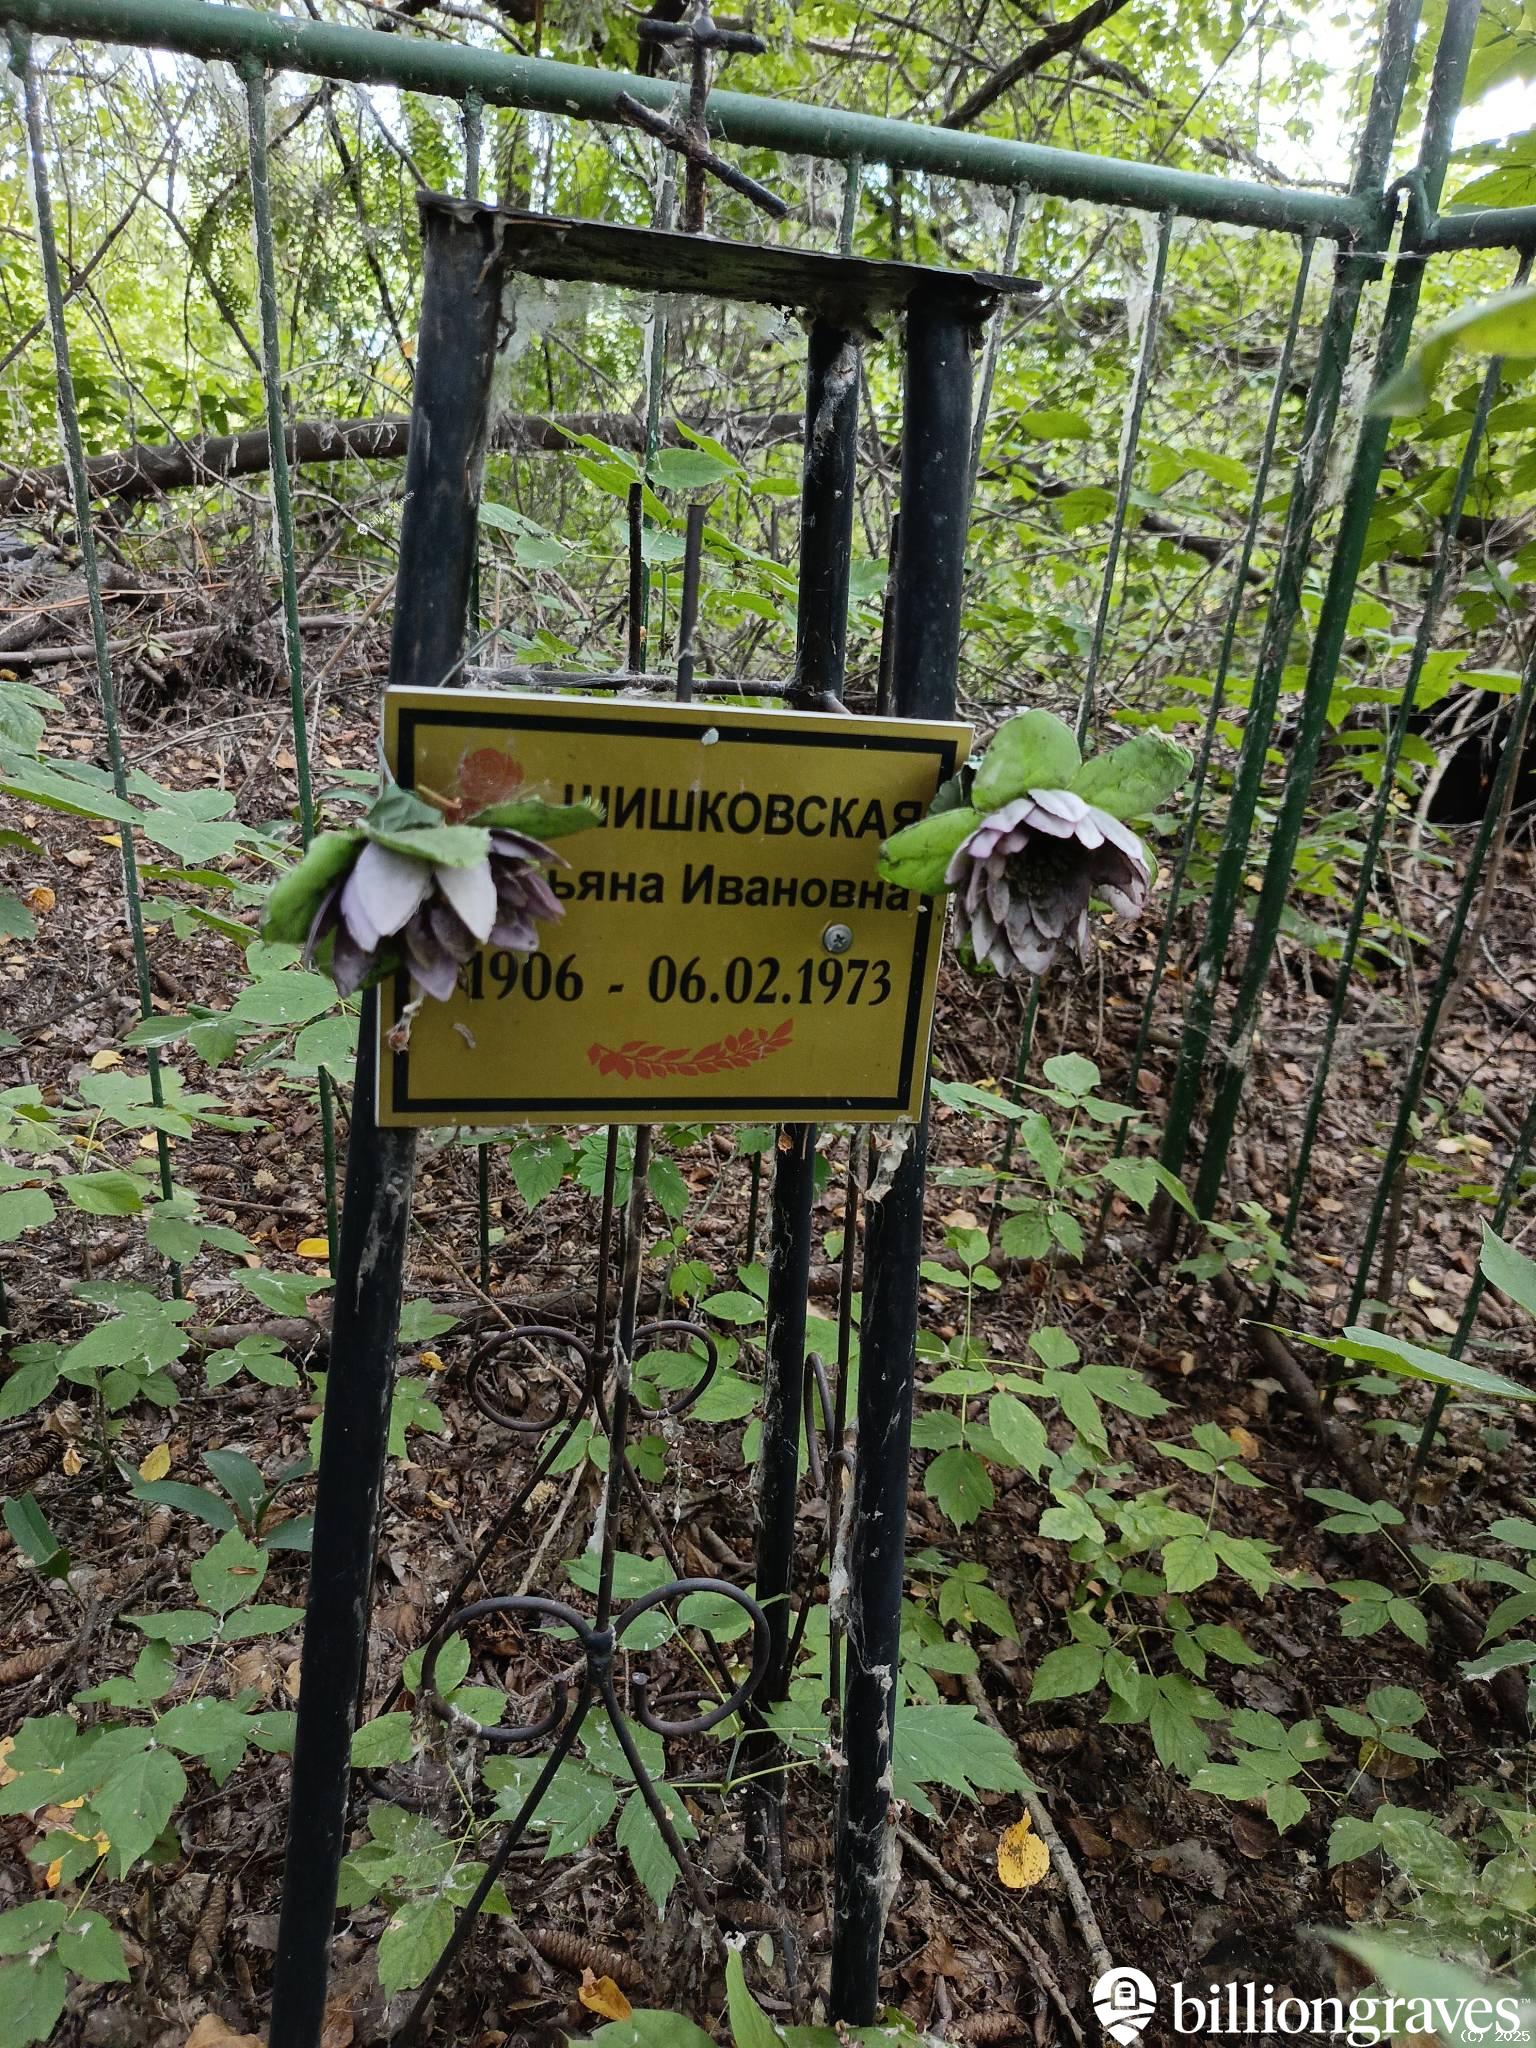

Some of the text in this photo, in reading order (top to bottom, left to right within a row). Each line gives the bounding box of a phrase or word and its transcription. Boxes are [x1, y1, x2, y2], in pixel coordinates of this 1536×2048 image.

[548, 864, 910, 911] ьяна Ивановна
[464, 950, 584, 1002] 1906
[648, 954, 892, 1006] 06.02.1973
